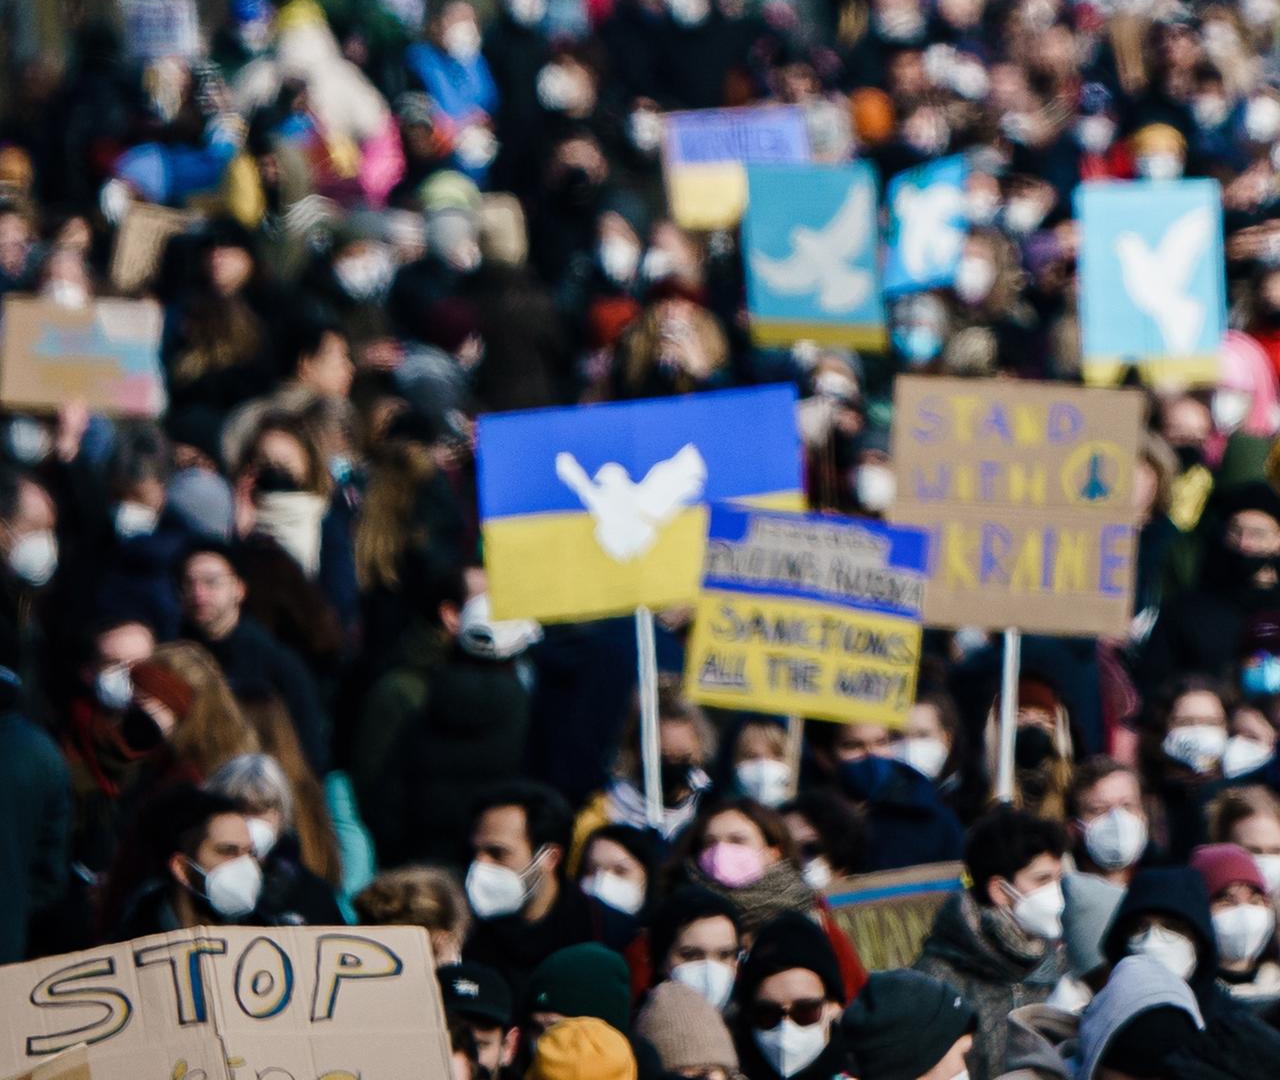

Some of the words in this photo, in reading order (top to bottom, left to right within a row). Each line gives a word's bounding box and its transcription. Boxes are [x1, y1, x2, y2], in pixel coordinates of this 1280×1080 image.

[913, 394, 1084, 449] STAND
[914, 460, 1049, 508] WITH
[936, 522, 1130, 598] KRAINE
[710, 597, 918, 666] SANCTIONS
[700, 650, 750, 686] ALL
[766, 654, 822, 696] THE
[26, 933, 403, 1056] STOP
